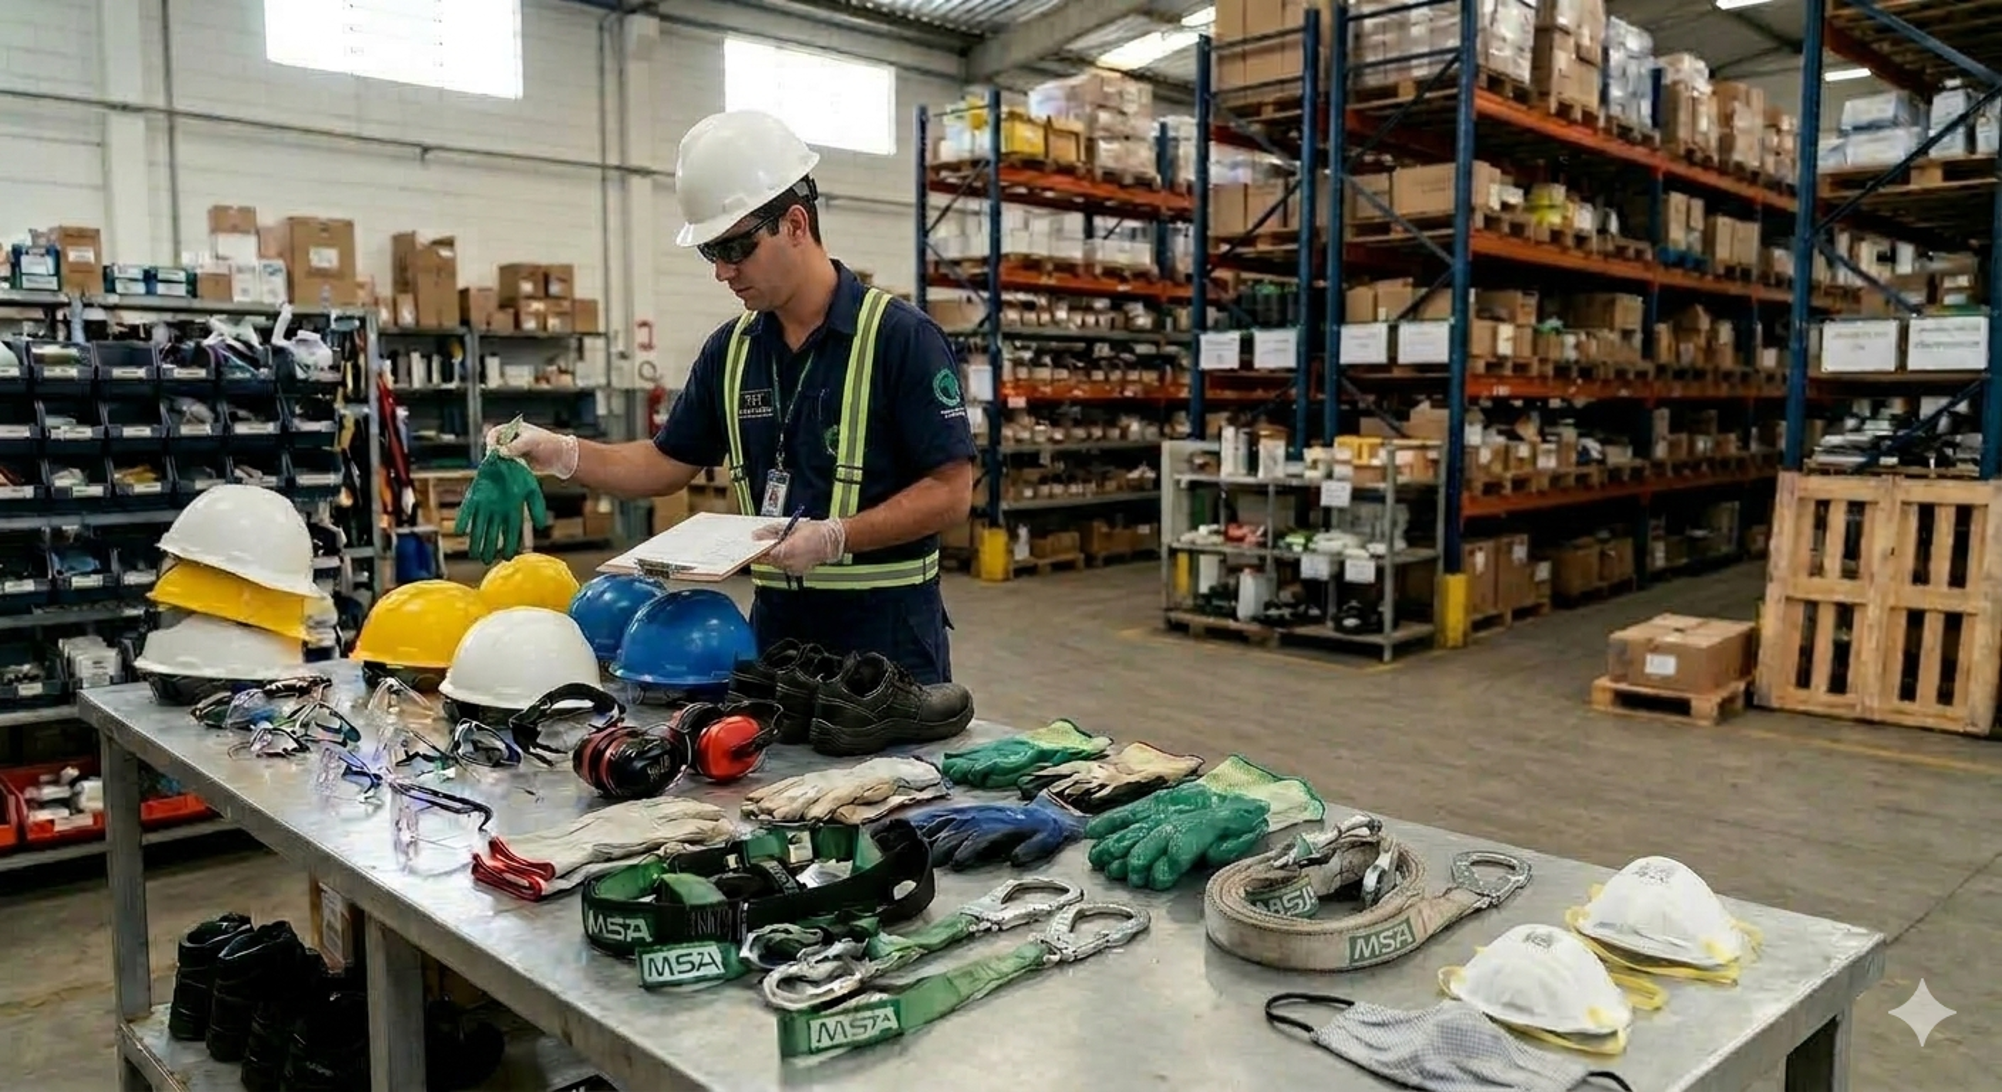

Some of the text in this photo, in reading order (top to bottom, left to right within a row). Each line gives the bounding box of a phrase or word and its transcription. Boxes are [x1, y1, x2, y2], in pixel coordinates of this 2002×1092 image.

[588, 909, 653, 942] MSA
[1353, 921, 1414, 960] MSA
[647, 952, 721, 978] MSA
